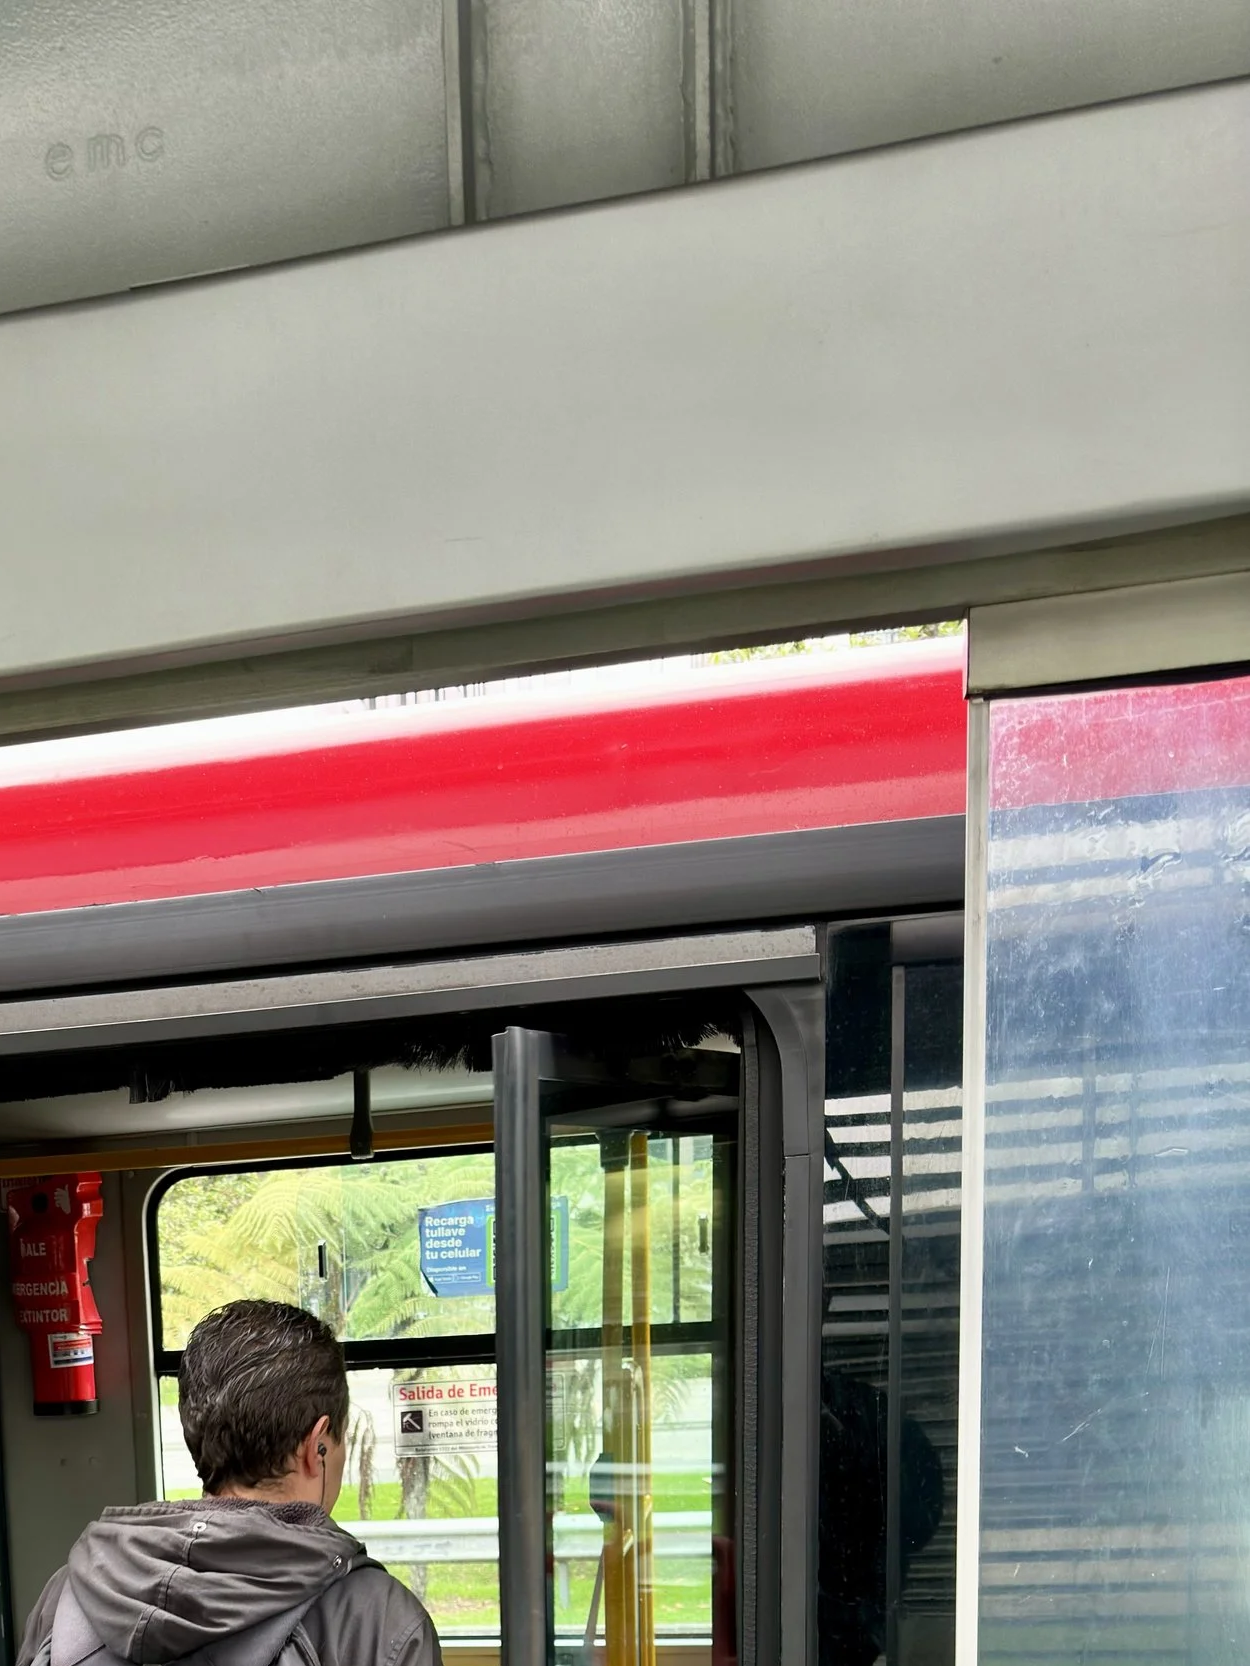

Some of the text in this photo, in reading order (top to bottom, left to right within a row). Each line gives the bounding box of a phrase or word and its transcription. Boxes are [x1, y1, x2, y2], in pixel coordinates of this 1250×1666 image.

[425, 1215, 475, 1228] Recarga
[425, 1227, 466, 1238] tullave
[425, 1238, 463, 1249] desde
[425, 1247, 482, 1260] tu celular
[399, 1385, 443, 1401] Salida
[447, 1384, 465, 1398] de
[428, 1408, 439, 1418] En
[440, 1409, 458, 1417] caso
[459, 1407, 470, 1416] de
[428, 1420, 454, 1429] rompa
[455, 1419, 464, 1427] el
[465, 1418, 489, 1427] vidrio
[465, 1429, 476, 1438] de
